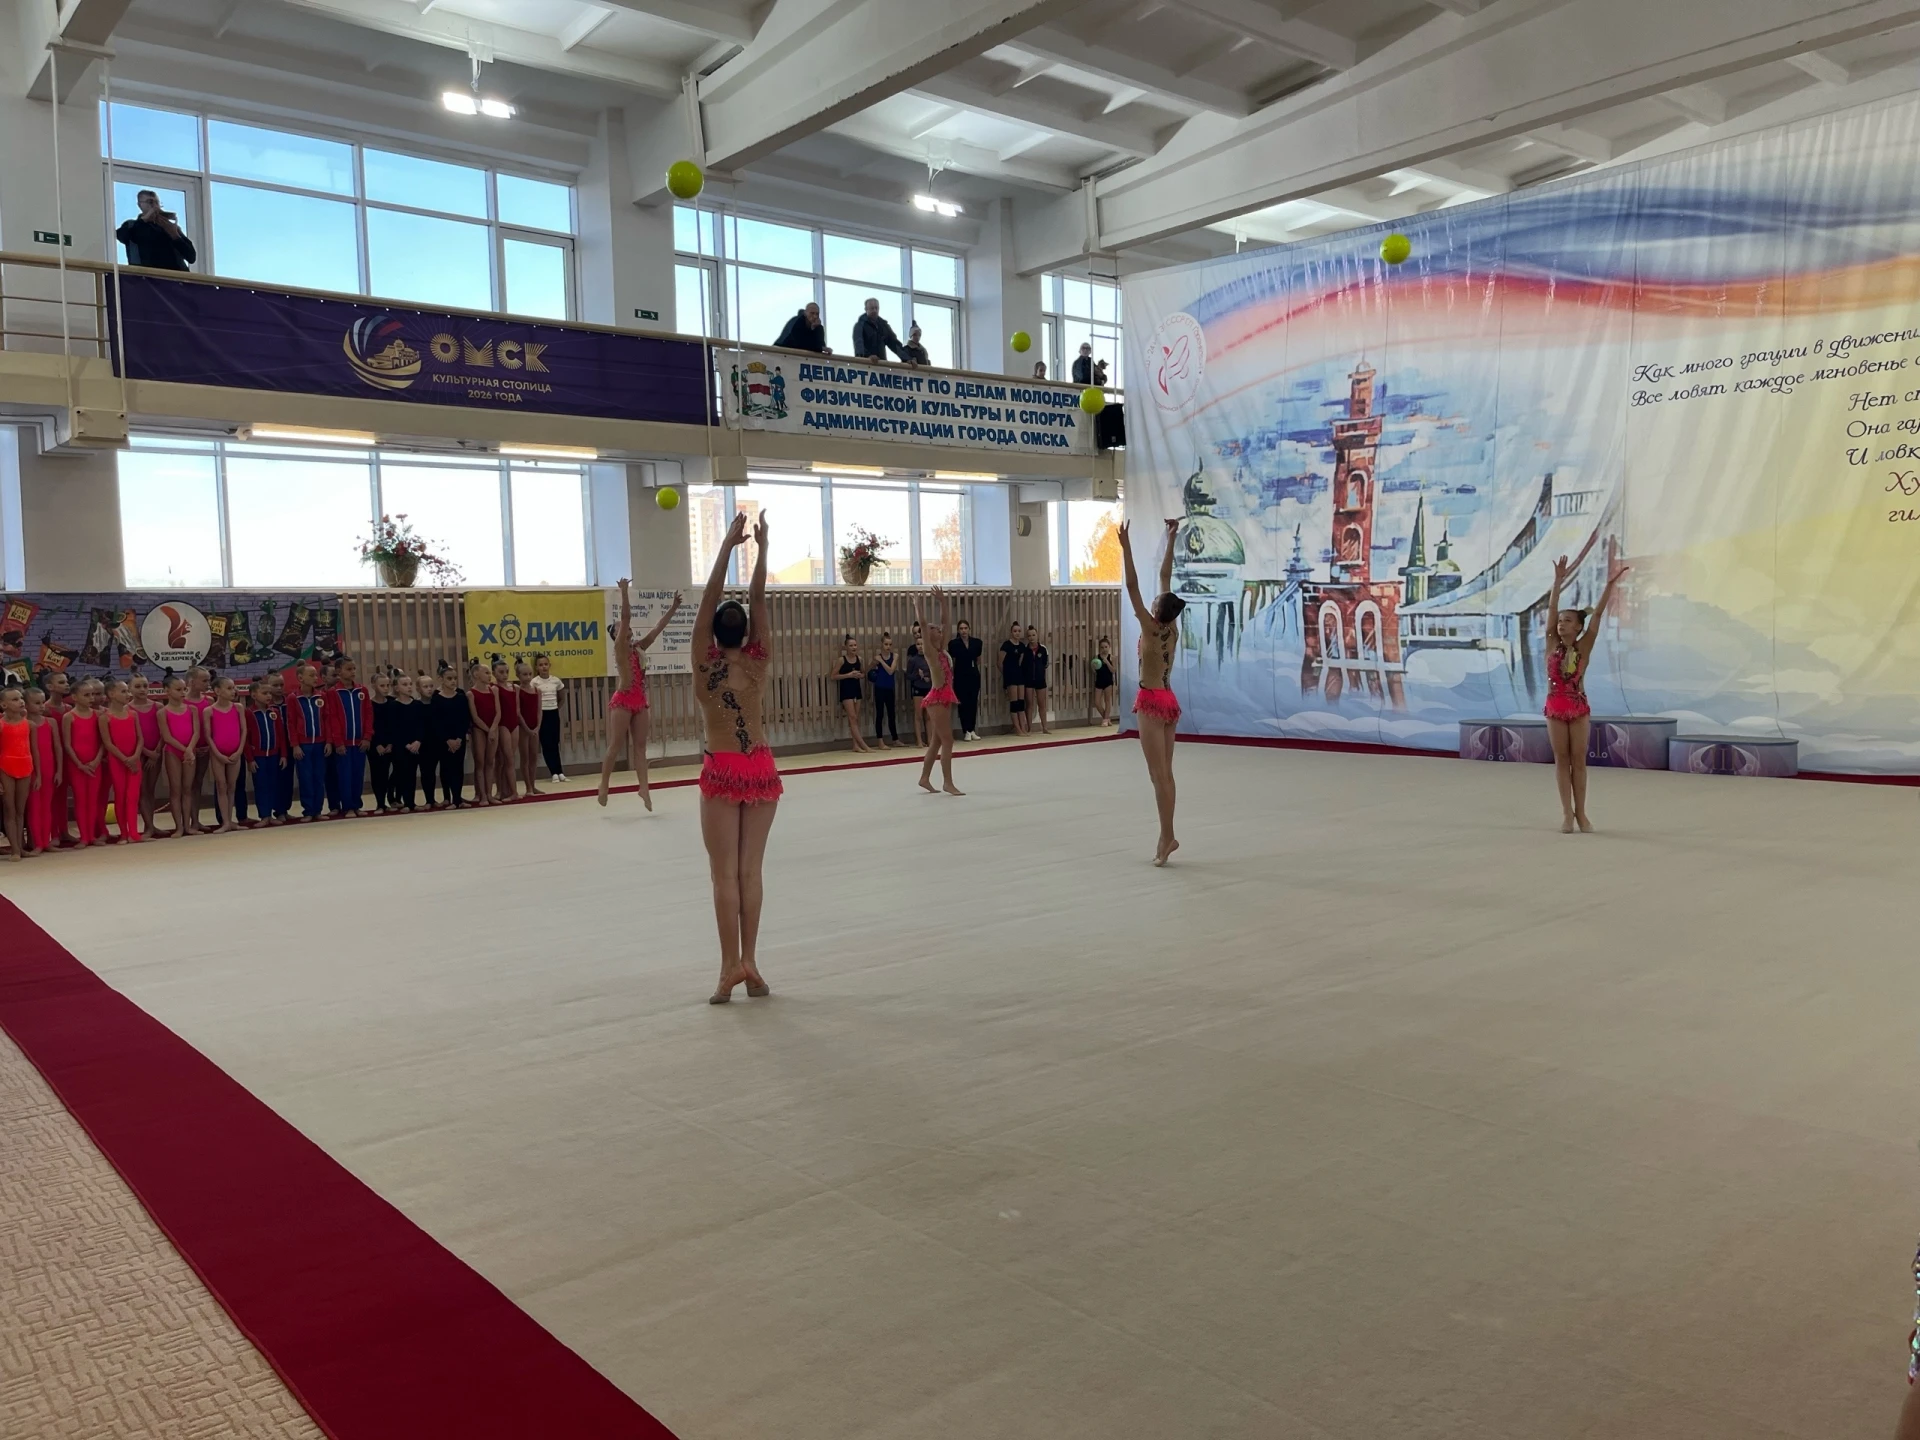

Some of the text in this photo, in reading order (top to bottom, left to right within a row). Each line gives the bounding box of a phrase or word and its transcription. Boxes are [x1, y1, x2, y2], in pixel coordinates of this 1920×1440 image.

[430, 333, 550, 373] ОМСК
[1632, 327, 1920, 383] Как много грации в движени
[432, 374, 552, 393] КУЛЬТУРНАЯ СТОЛИЦА
[799, 363, 1081, 409] ДЕПАРТАМЕНТ ПО ДЕЛАМ МОЛОДЕЖ
[1631, 390, 1663, 407] Все
[1668, 384, 1728, 401] ловят
[1733, 373, 1806, 395] каждое
[1810, 359, 1909, 382] мгновенье
[468, 389, 523, 402] 2026 ГОДА
[1847, 391, 1899, 412] Нет
[800, 387, 1075, 428] ФИЗИЧЕСКОЙ КУЛЬТУРЫ И СПОРТА
[803, 411, 1070, 448] АДМИНИСТРАЦИИ ГОРОДА ОМСКА
[1846, 420, 1891, 438] Она
[1845, 444, 1920, 466] И ловк
[1885, 470, 1920, 496] Ху
[1888, 509, 1920, 522] ги
[656, 591, 674, 600] АДРЕС
[509, 649, 552, 659] часовых
[554, 648, 594, 657] салонов
